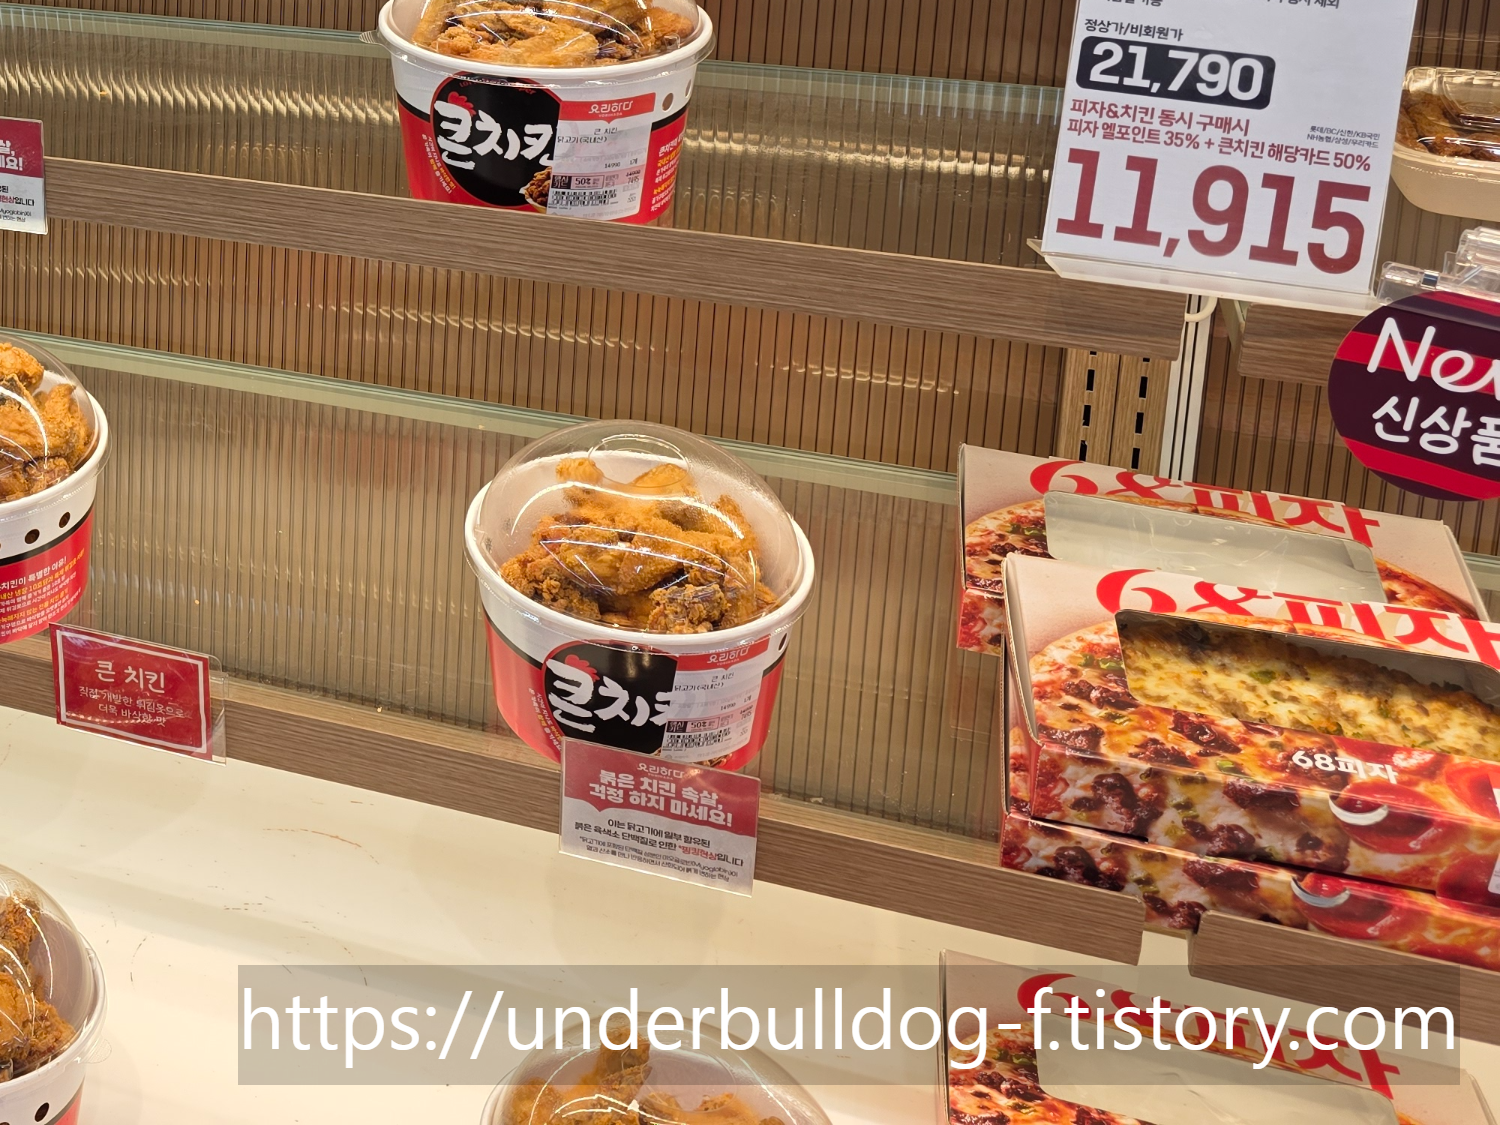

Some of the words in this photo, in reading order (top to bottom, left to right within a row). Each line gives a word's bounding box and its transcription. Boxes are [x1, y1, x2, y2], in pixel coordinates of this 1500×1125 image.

[1084, 18, 1184, 41] 정상가/비회원가
[1089, 40, 1265, 101] 21,790
[589, 101, 633, 114] 요리하다
[1070, 98, 1155, 125] 피자&치킨
[1157, 109, 1193, 130] 동시
[1196, 113, 1250, 137] 구매시
[1067, 118, 1099, 140] 피자
[1101, 122, 1161, 146] 엘포인트
[1163, 130, 1200, 150] 35%
[1218, 136, 1266, 160] 큰치킨
[1267, 143, 1331, 168] 해당카드
[1333, 152, 1371, 172] 50%
[1056, 148, 1372, 274] 11,915
[1367, 317, 1500, 402] Ne
[707, 646, 750, 664] 요리하다
[95, 660, 115, 682] 큰
[125, 666, 165, 693] 치킨
[637, 762, 685, 779] 요리하다
[1292, 749, 1398, 784] 68피자
[589, 783, 624, 803] 걱정
[629, 790, 664, 811] 하지
[670, 800, 733, 827] 마세요!
[599, 770, 635, 789] 붉은
[640, 777, 676, 798] 치킨
[681, 786, 723, 810] 속살,
